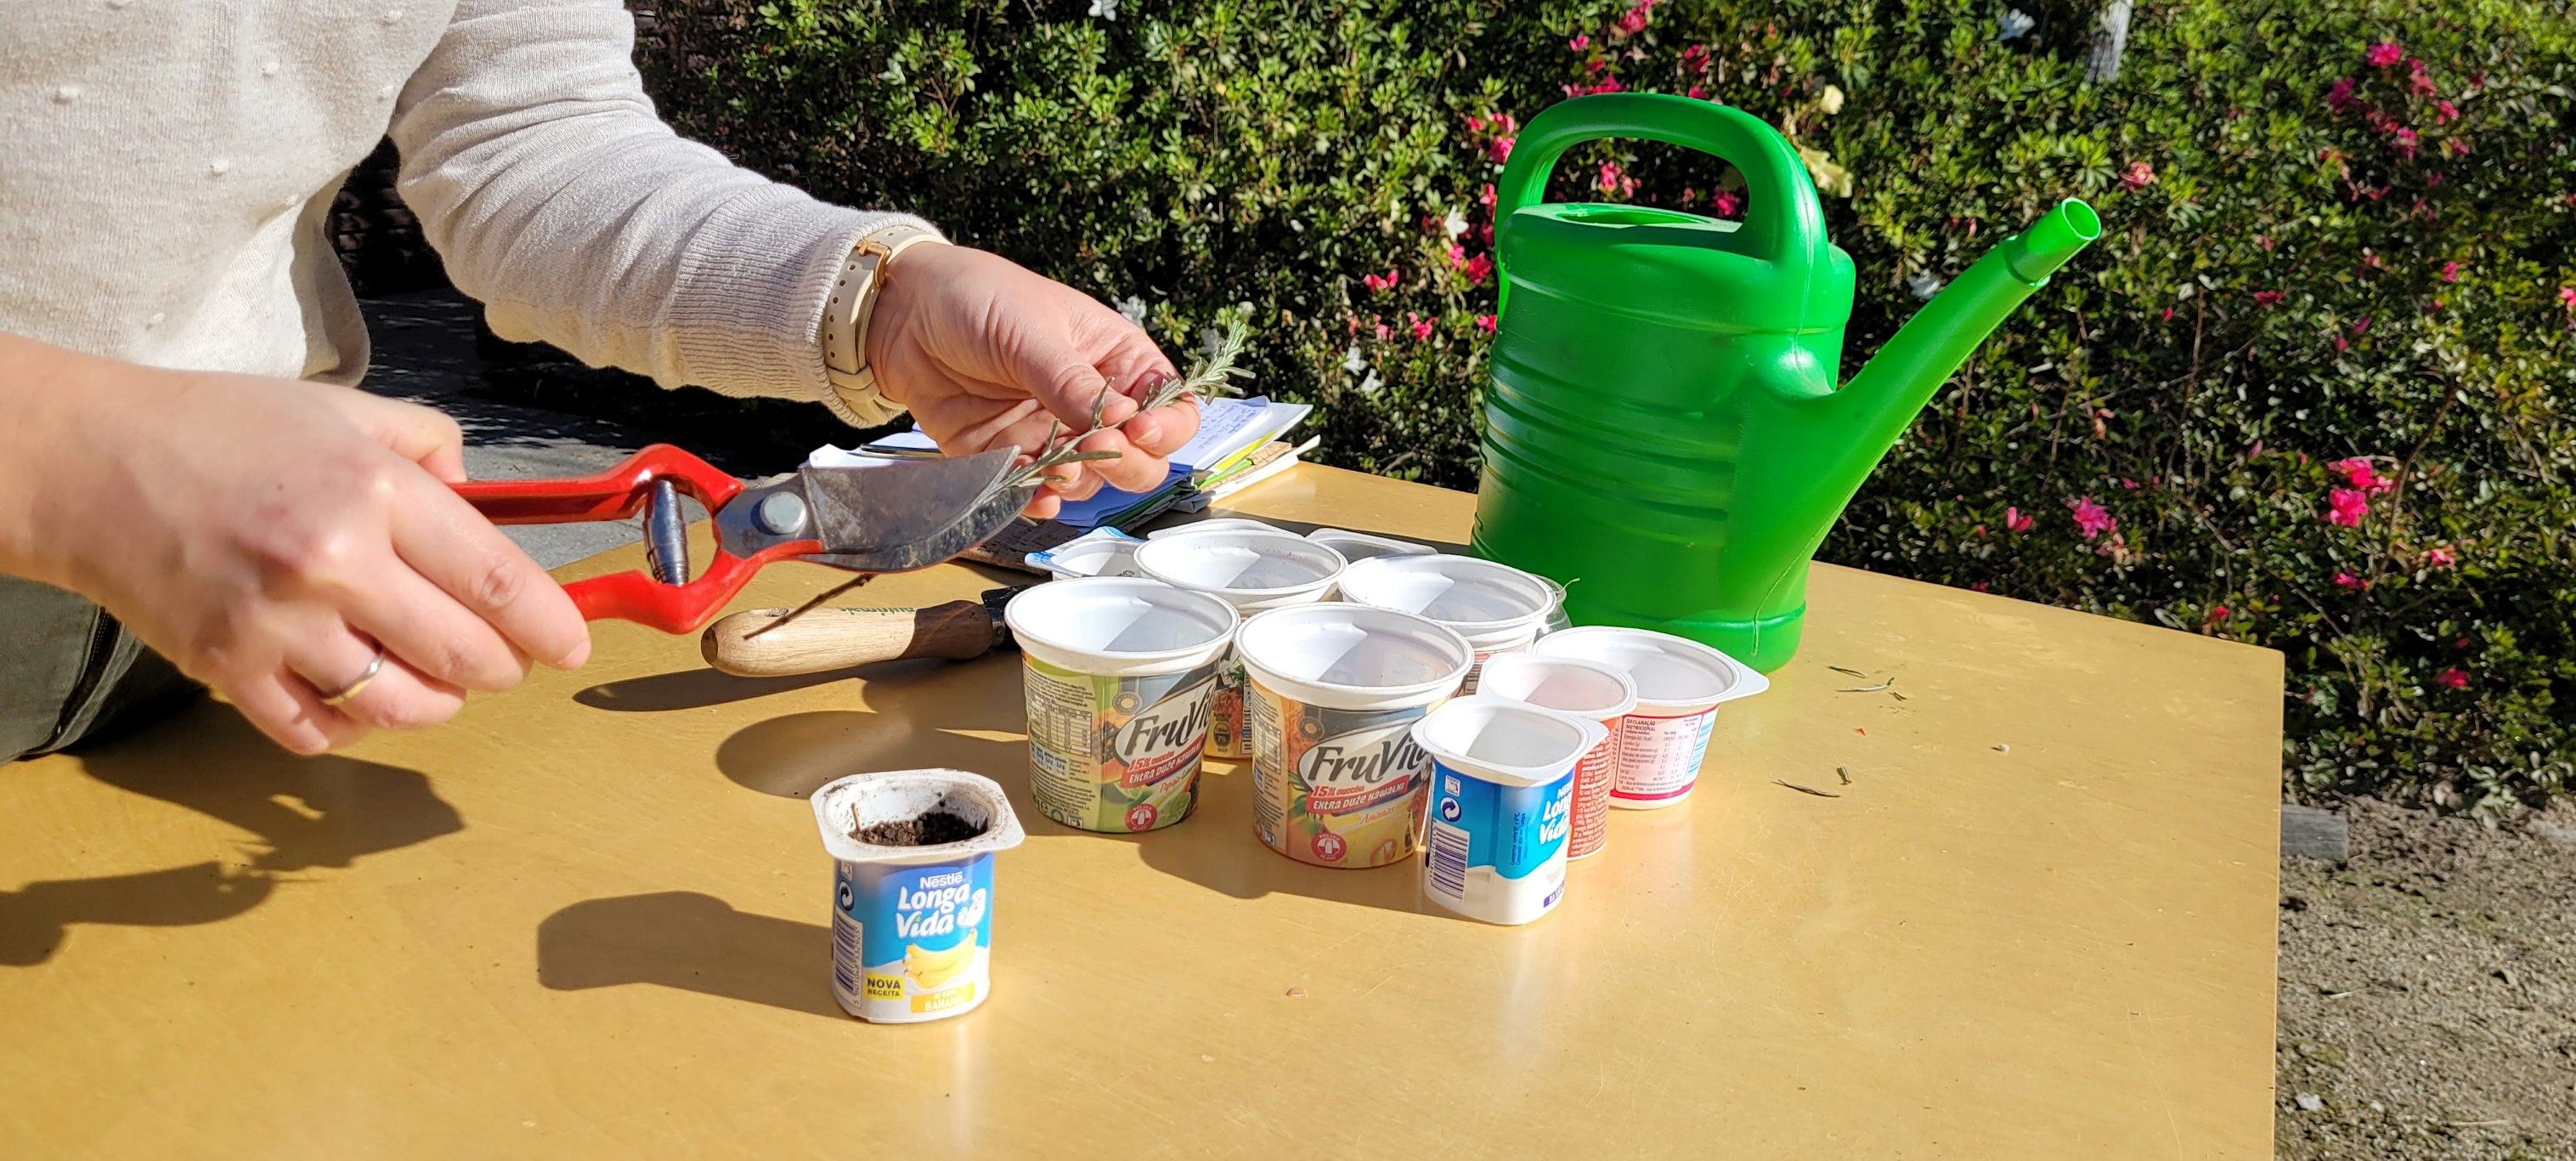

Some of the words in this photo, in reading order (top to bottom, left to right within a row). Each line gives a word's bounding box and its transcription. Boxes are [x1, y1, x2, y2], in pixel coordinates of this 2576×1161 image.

[1128, 756, 1151, 772] 15%
[1313, 785, 1336, 796] 15%
[919, 871, 963, 889] Nestlé
[898, 883, 970, 914] Longa
[896, 910, 954, 938] Vida
[867, 977, 901, 989] NOVA
[867, 988, 901, 997] RECEITA
